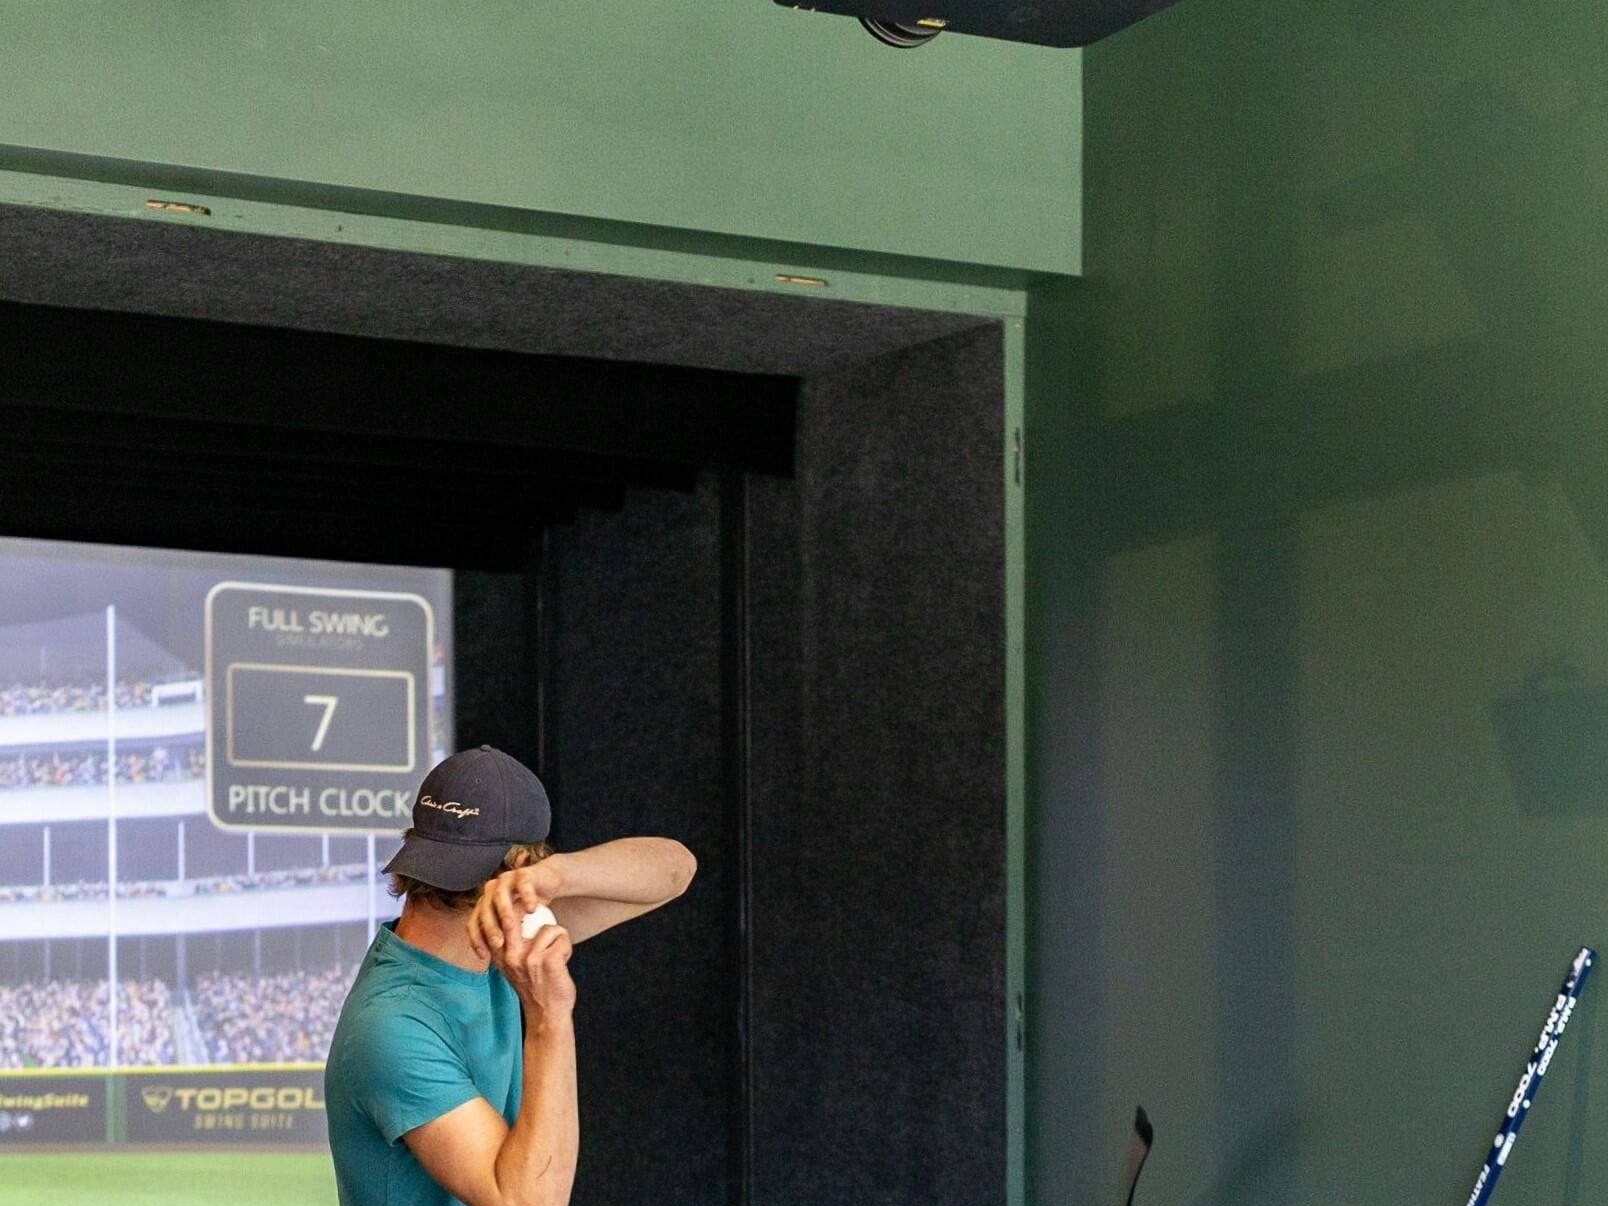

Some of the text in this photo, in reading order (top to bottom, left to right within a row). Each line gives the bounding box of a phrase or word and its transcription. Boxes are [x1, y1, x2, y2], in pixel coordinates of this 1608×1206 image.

[247, 606, 390, 638] FULL SWING
[304, 695, 339, 751] 7
[228, 785, 412, 817] PITCH CLOCK
[175, 1086, 326, 1110] TOPGOL
[1506, 1061, 1537, 1118] 7000
